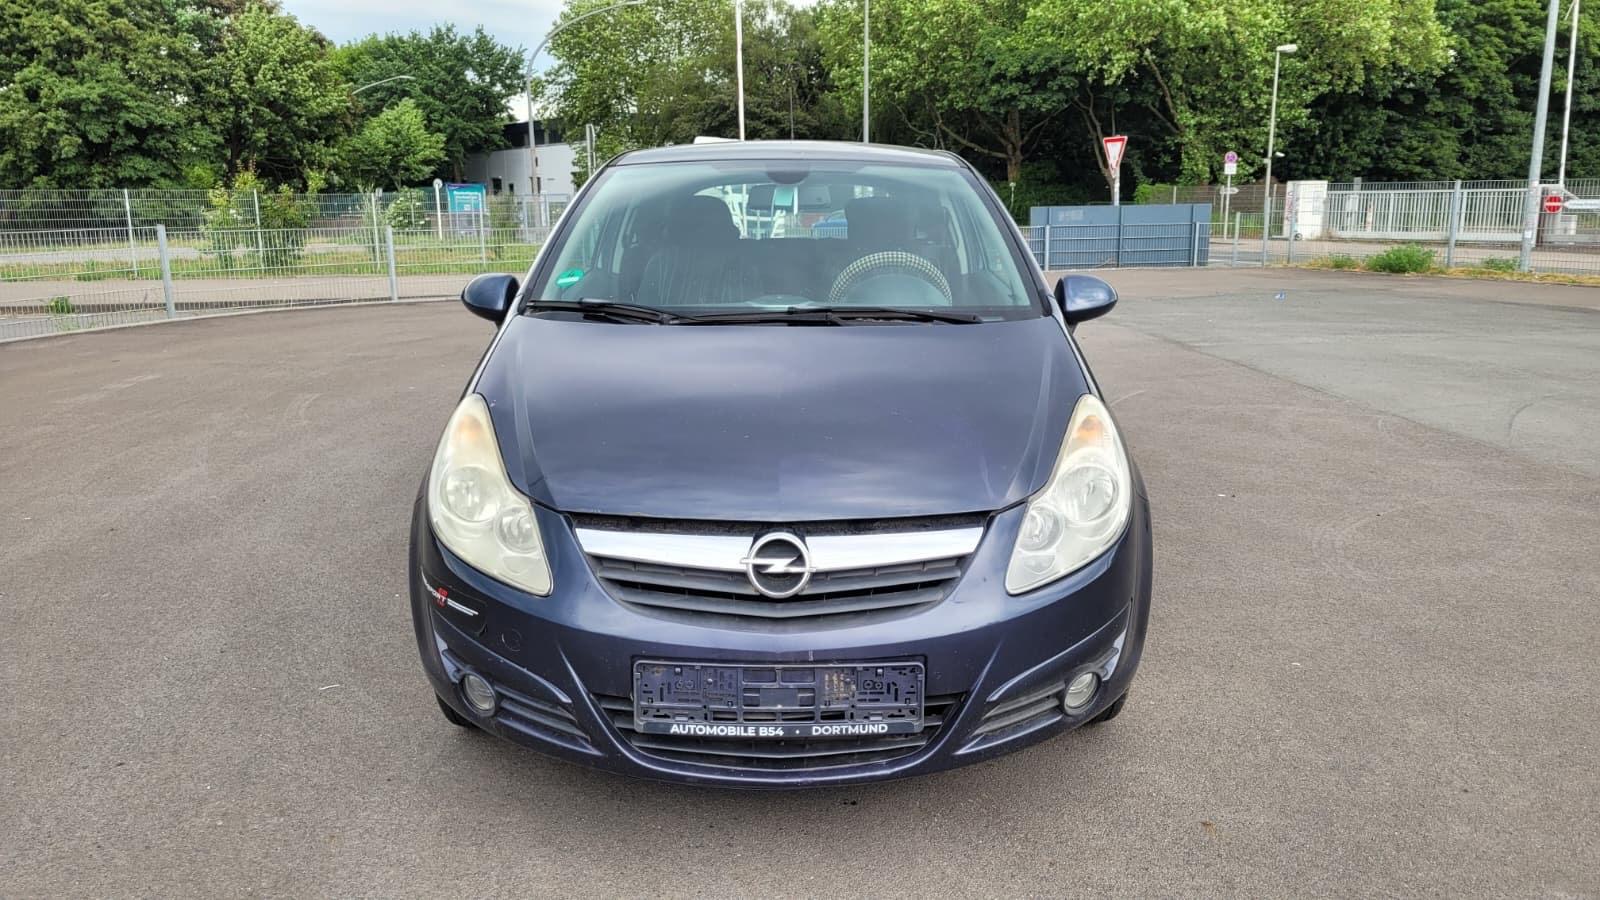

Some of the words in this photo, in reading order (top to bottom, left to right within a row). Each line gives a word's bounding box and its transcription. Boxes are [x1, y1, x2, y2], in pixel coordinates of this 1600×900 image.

[670, 724, 756, 736] AUTOMOBILE
[759, 726, 784, 736] B54
[812, 723, 888, 736] DORTMUND
